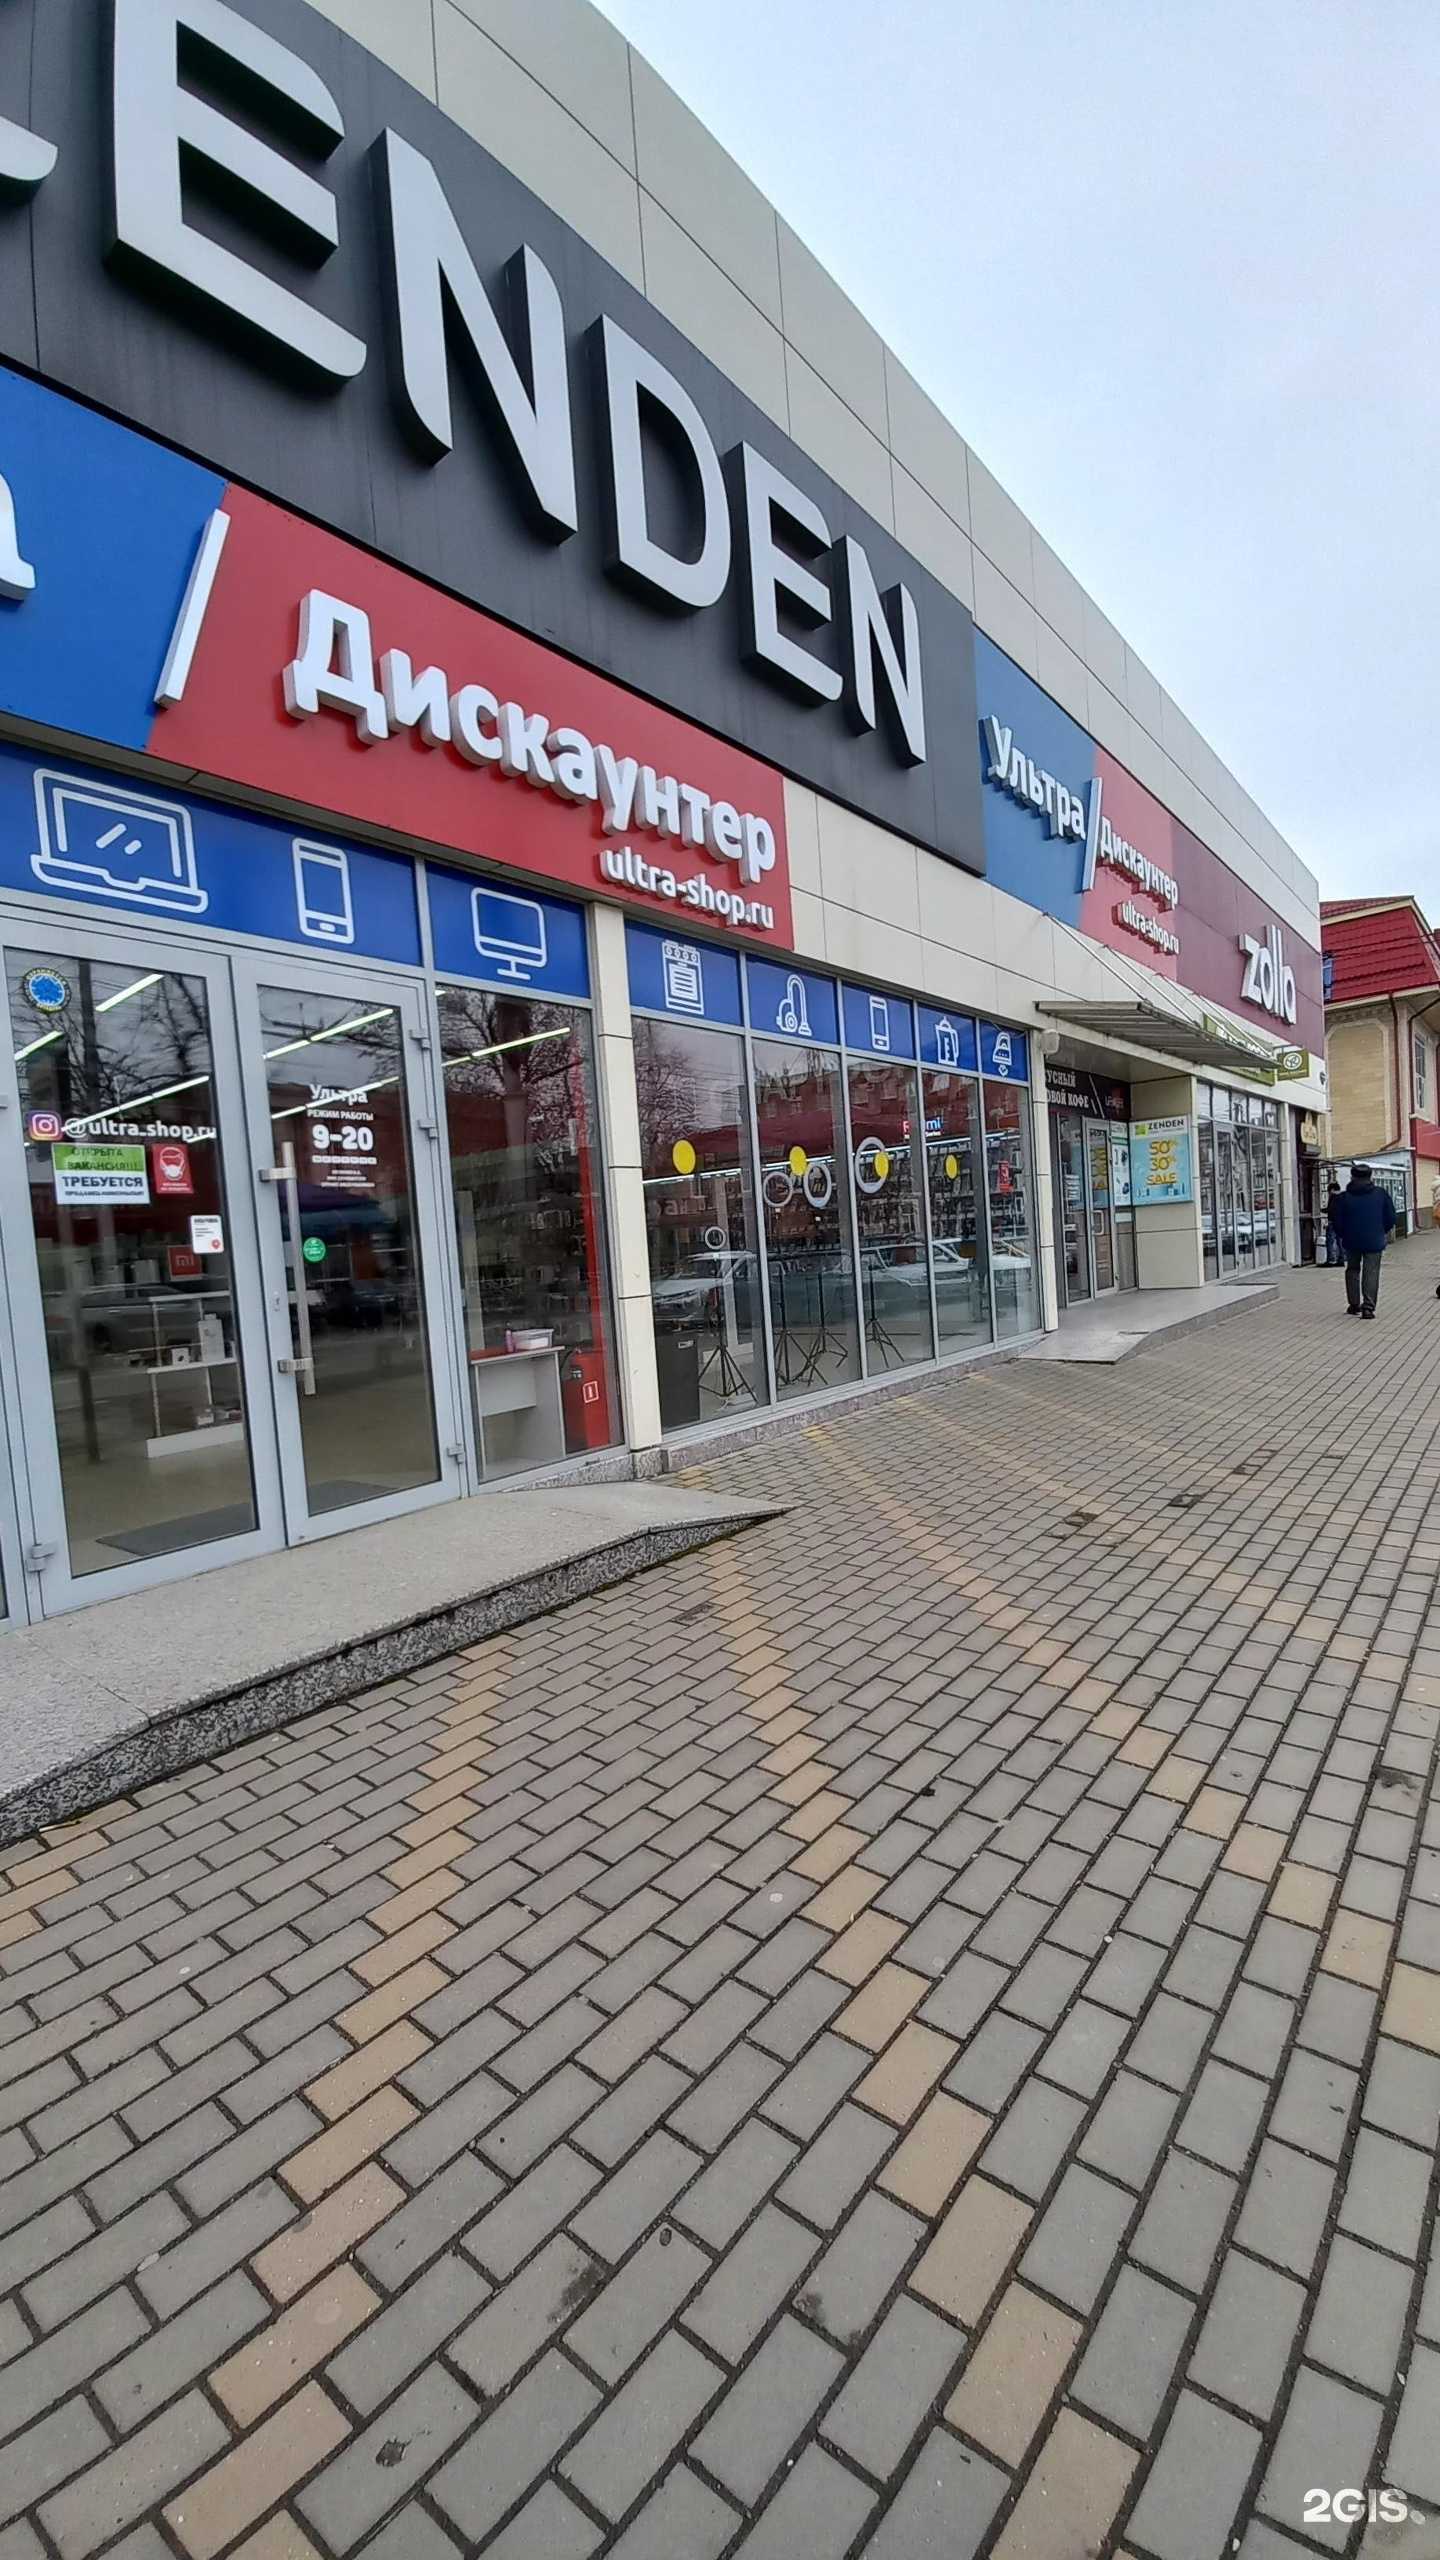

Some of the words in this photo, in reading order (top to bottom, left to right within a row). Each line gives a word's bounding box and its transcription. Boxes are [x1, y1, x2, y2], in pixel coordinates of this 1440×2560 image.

[0, 0, 926, 768] ENDEN
[283, 588, 777, 886] Дискаунтер
[981, 714, 1087, 841] Ультра
[1099, 816, 1178, 909] Дискаунтер
[598, 846, 775, 931] ultra-shop.ru
[1117, 901, 1179, 954] ultra-shop.ru
[1238, 924, 1297, 1025] zolla
[1046, 1070, 1076, 1087] УСНЫЙ
[309, 1083, 368, 1105] Ультра
[1067, 1093, 1089, 1108] КОФЕ
[307, 1109, 340, 1119] РЕЖИМ
[340, 1110, 374, 1120] РАБОТЫ
[1147, 1119, 1184, 1130] ZENDEN
[312, 1124, 374, 1151] 9-20
[62, 1176, 143, 1187] ТРЕБУЕТСЯ
[1146, 1173, 1177, 1186] SALE
